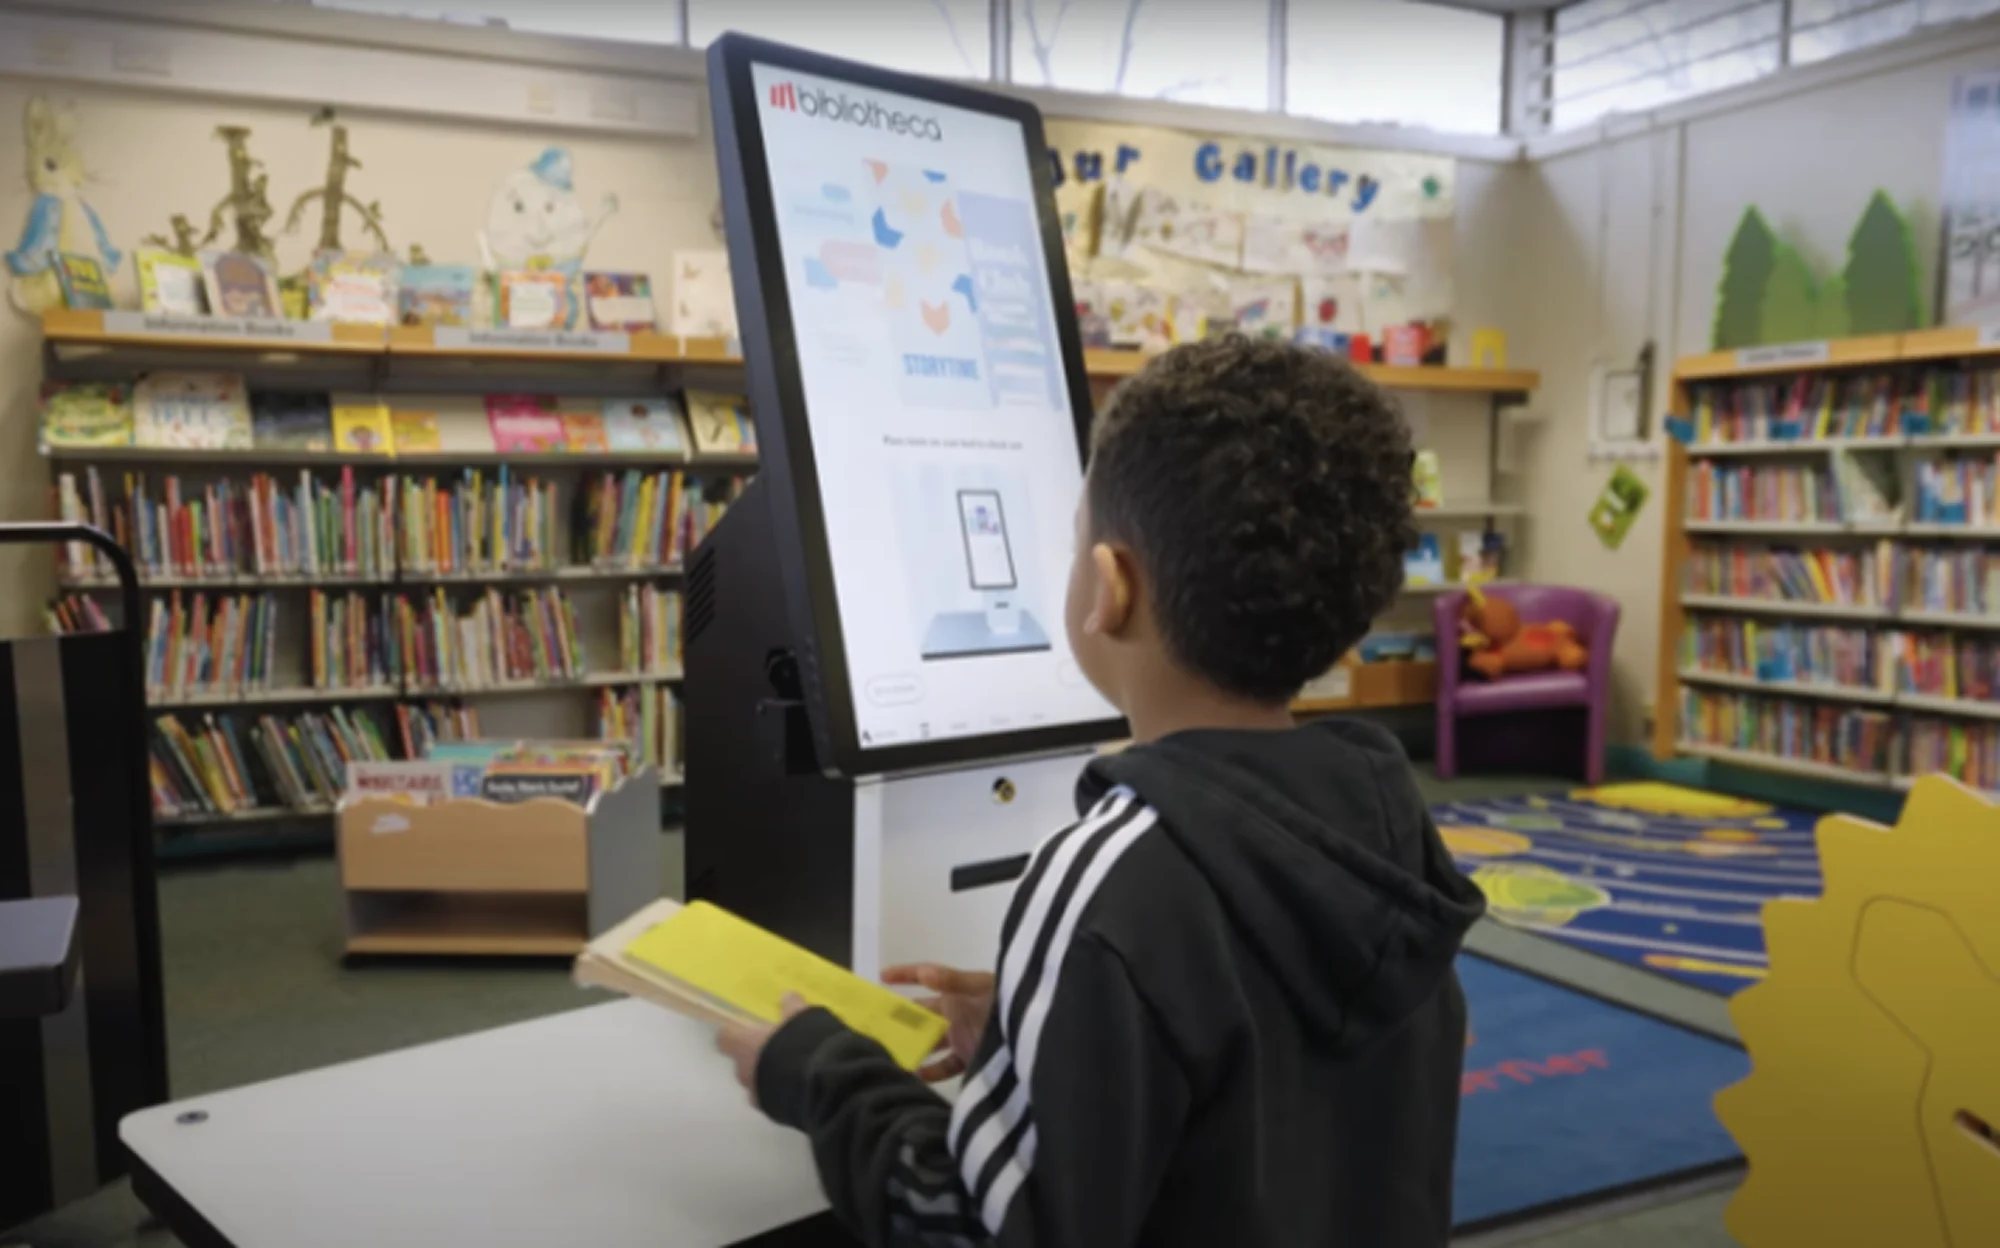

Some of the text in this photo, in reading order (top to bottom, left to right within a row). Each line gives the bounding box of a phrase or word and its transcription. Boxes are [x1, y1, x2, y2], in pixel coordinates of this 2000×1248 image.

[798, 83, 942, 142] bibliotheca
[1194, 140, 1380, 214] Gallery
[144, 315, 241, 334] Information
[902, 353, 980, 381] STORYTIME
